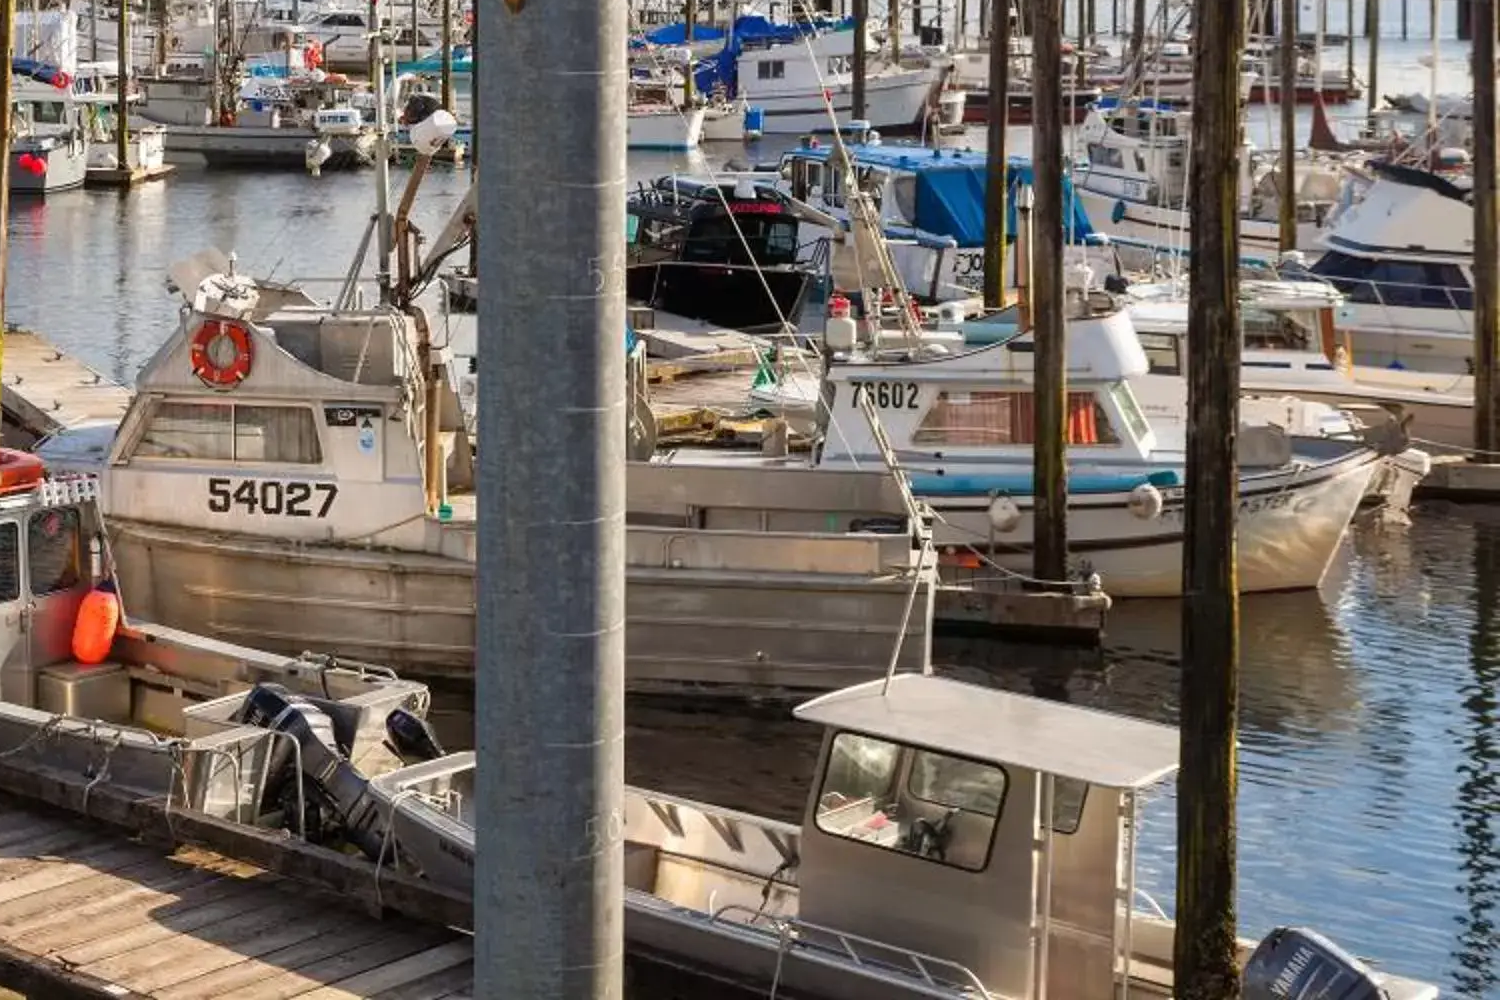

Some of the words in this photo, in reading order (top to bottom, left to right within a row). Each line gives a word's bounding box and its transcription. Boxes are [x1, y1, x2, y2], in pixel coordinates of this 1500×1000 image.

[952, 253, 984, 275] FJO
[208, 477, 339, 518] 54027
[1269, 946, 1316, 997] YAMAHA
